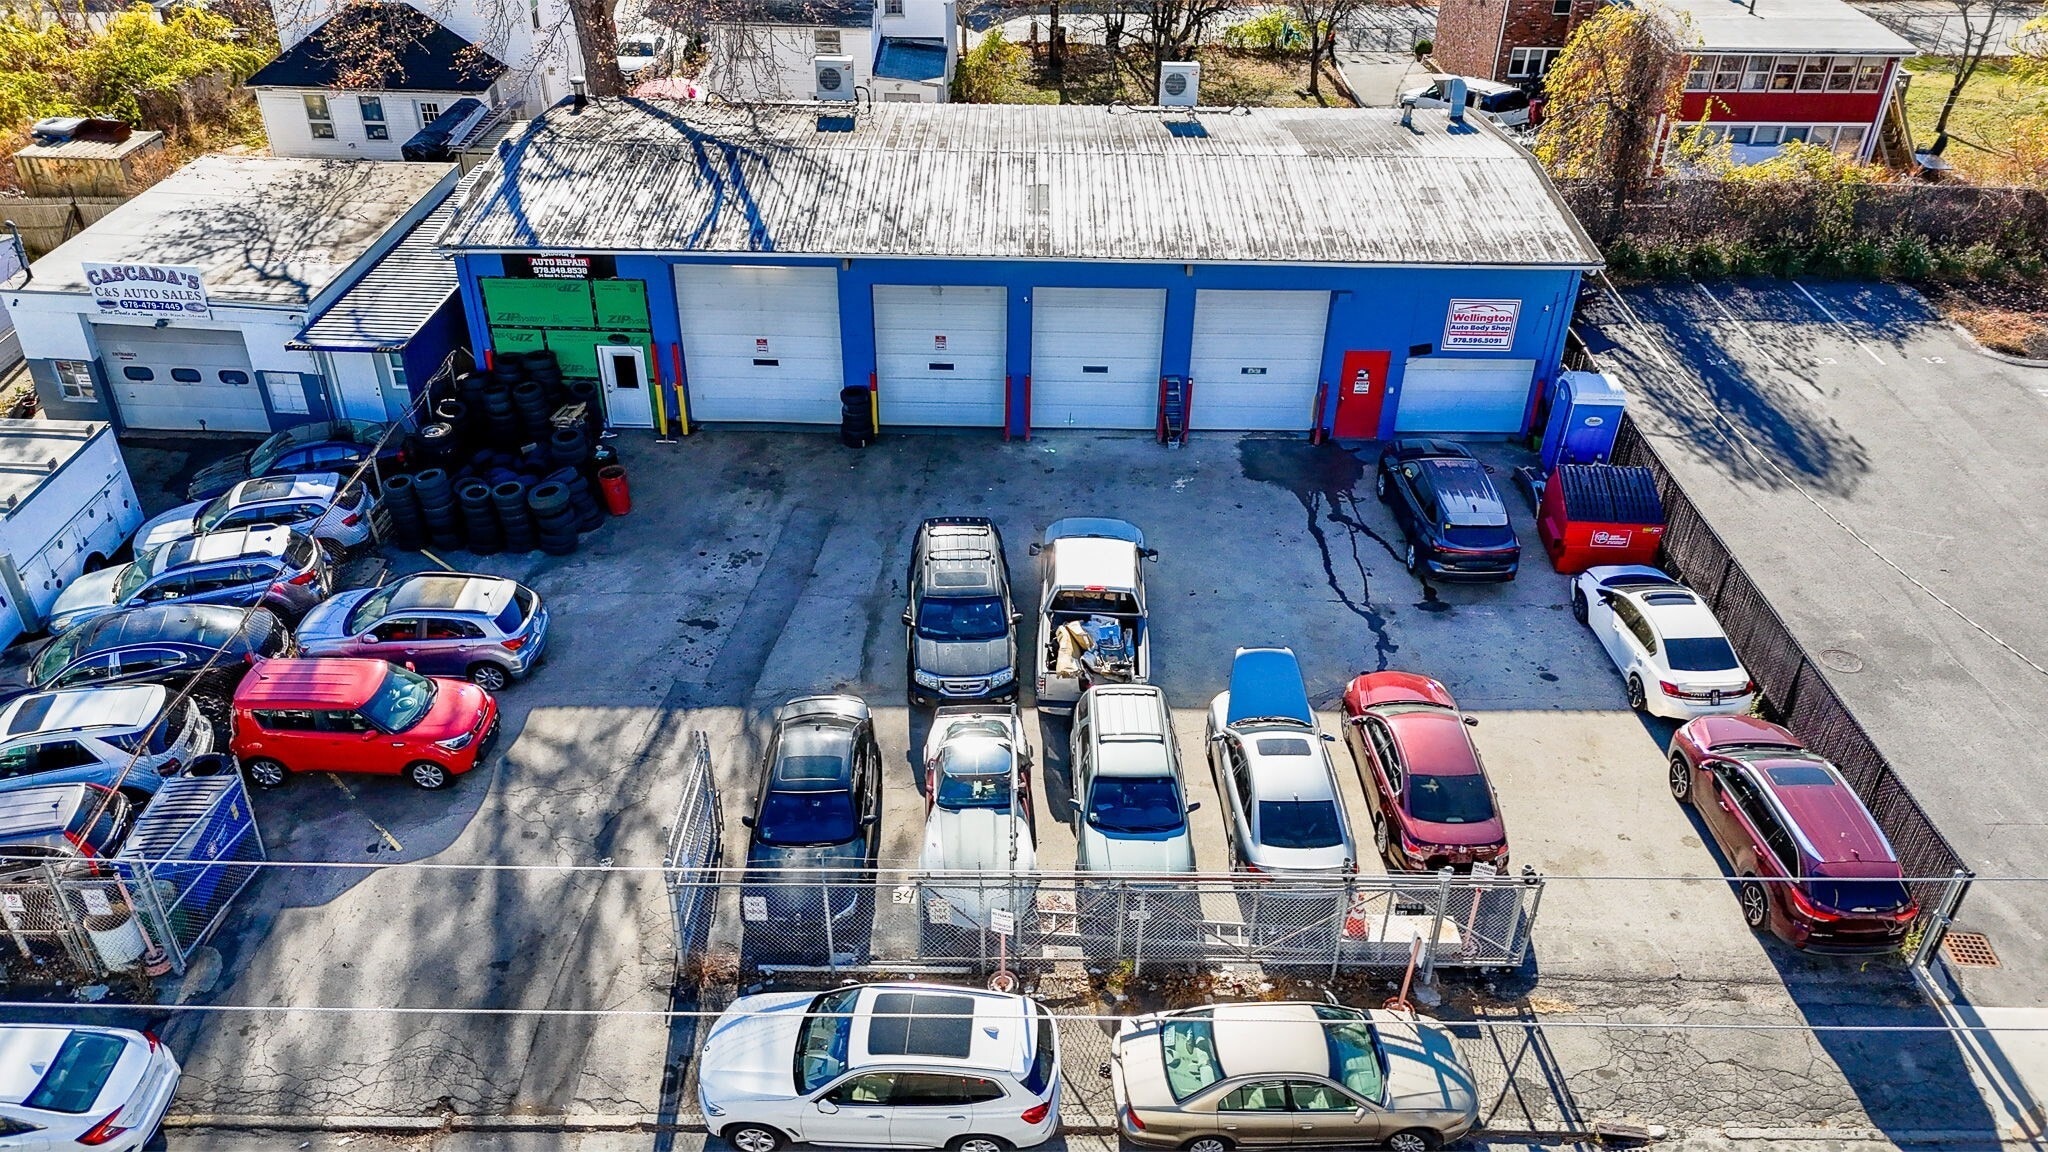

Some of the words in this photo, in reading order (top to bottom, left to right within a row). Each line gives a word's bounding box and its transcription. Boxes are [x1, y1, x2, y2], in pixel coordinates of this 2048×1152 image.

[531, 258, 555, 266] AUTO
[556, 258, 588, 267] REPAIR
[87, 265, 200, 290] CASCADA'S
[95, 286, 120, 298] C&S
[124, 288, 159, 299] AUTO
[162, 289, 202, 301] SALES
[122, 301, 180, 310] 978-479-7445
[1453, 313, 1513, 323] Wellington
[894, 889, 915, 904] 34
